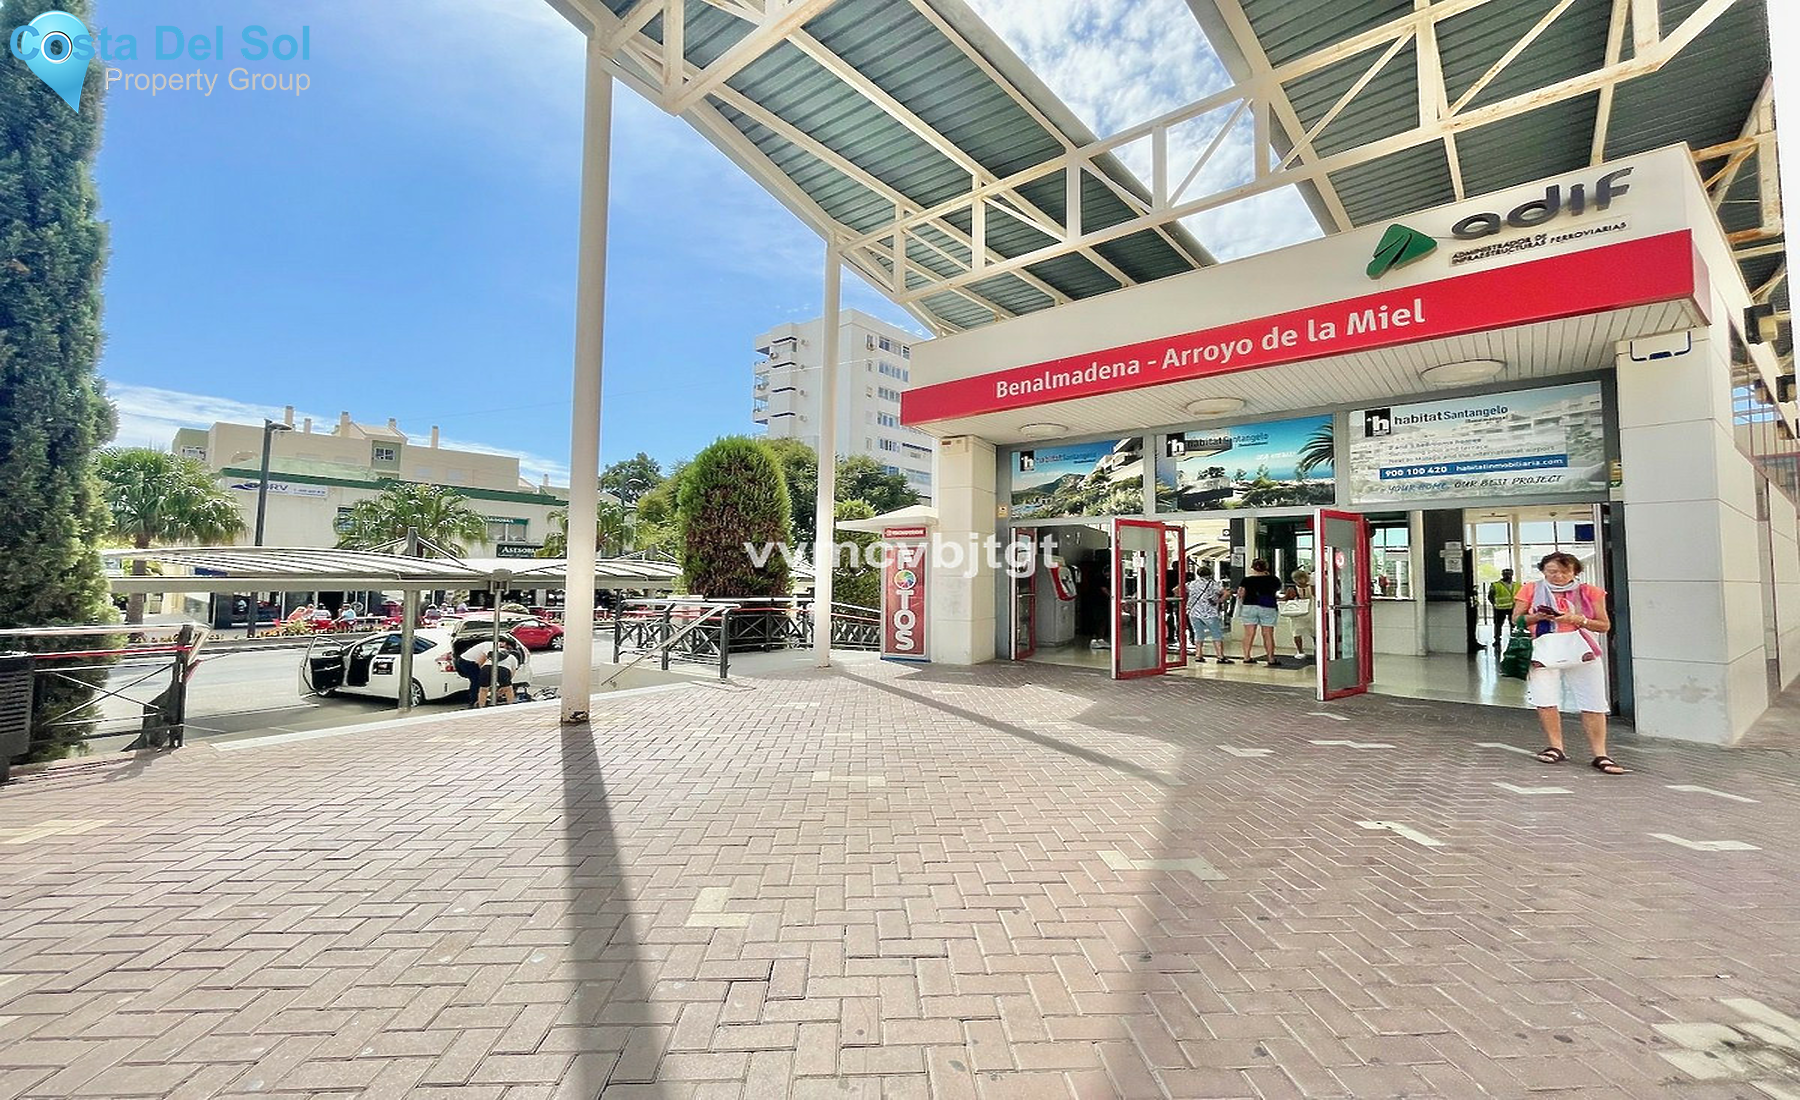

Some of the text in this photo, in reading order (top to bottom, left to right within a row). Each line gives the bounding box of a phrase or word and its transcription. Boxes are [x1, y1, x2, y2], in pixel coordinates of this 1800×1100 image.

[1451, 166, 1635, 240] adif
[1451, 221, 1627, 265] INFRAESTRUCTURAS FERROVIARIAS
[1451, 233, 1548, 259] ADMINISTRADOR DE
[995, 358, 1140, 399] Benalmadena
[1162, 336, 1254, 370] Arroyo
[1262, 326, 1298, 351] de
[1308, 318, 1336, 342] la
[1346, 298, 1426, 337] Miel
[1385, 468, 1404, 478] 900
[1407, 467, 1425, 476] 100
[1427, 465, 1448, 475] 420
[1454, 480, 1478, 489] OUR
[1480, 477, 1508, 488] BEST
[1511, 474, 1563, 486] PROJECT
